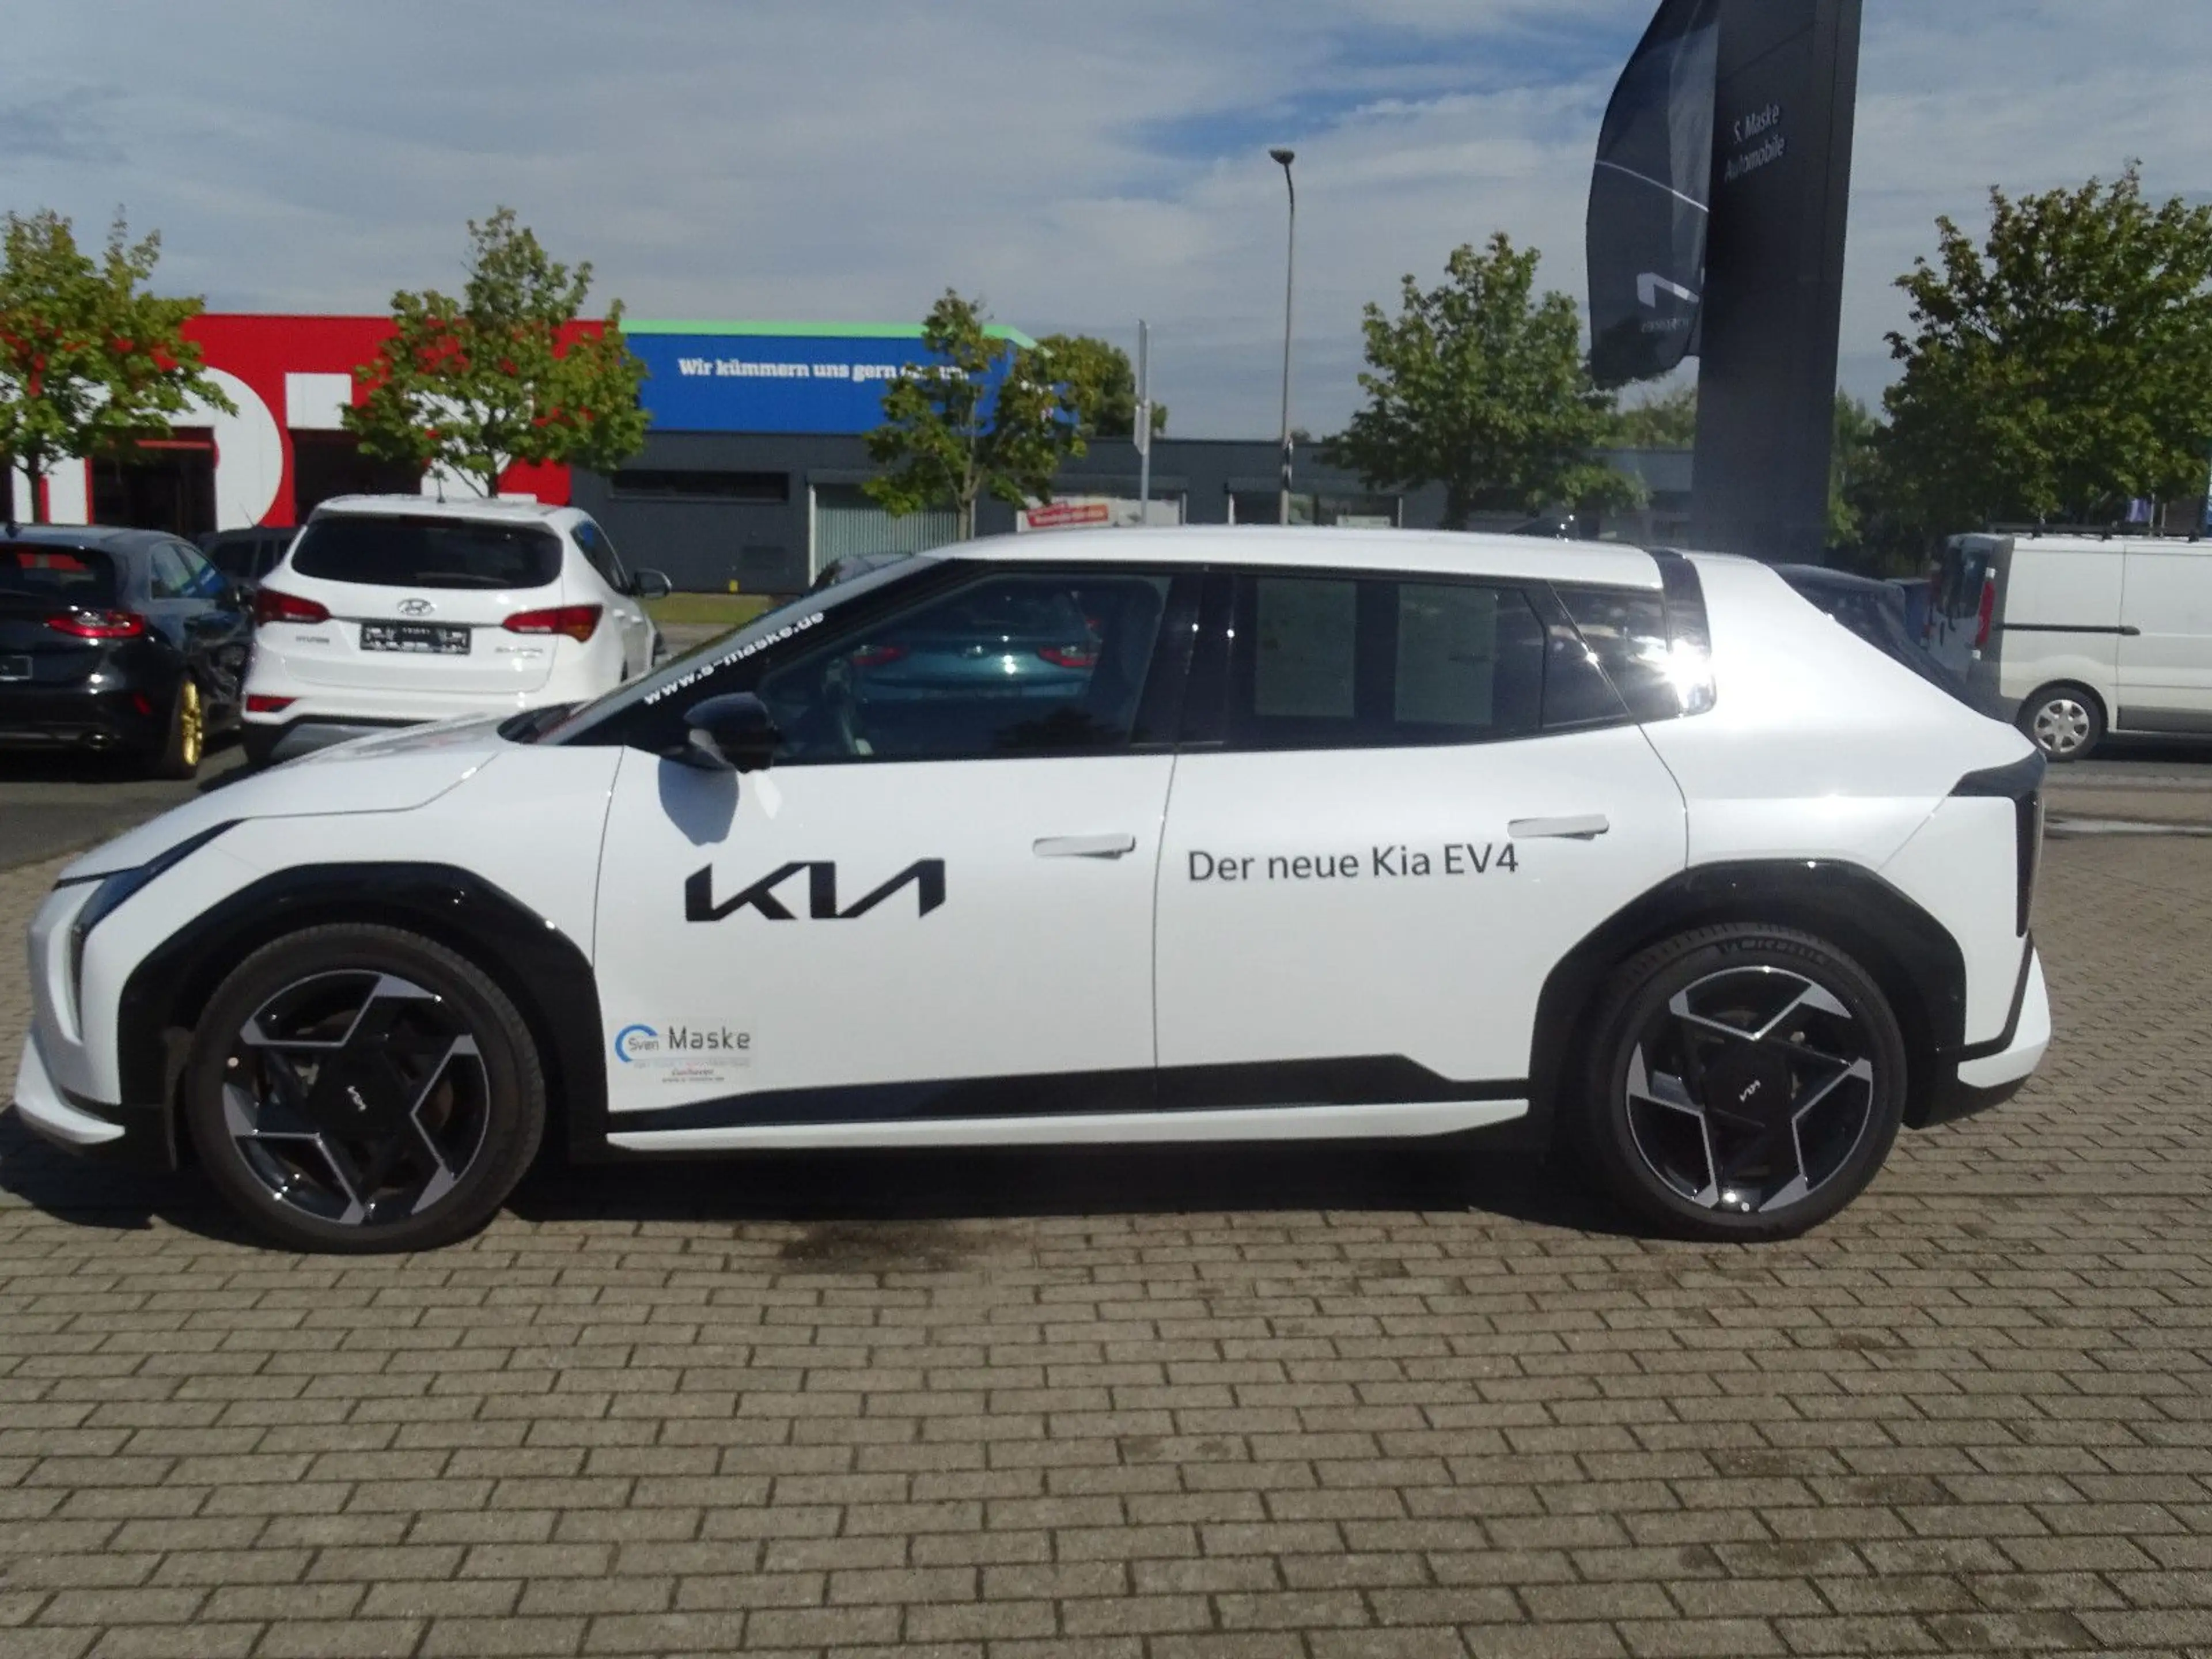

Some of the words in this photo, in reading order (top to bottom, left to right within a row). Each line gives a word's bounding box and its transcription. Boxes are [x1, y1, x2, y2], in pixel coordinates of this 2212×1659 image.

[1744, 103, 1779, 139] Maske
[1724, 134, 1785, 183] Automobile
[677, 358, 713, 376] Wir
[715, 358, 809, 377] kümmern
[812, 363, 850, 378] uns
[853, 364, 897, 382] gern
[644, 612, 824, 705] www.s-maske.de
[1188, 850, 1255, 881] Der
[1267, 854, 1359, 880] neue
[1371, 844, 1431, 878] Kia
[1442, 842, 1518, 875] EV4
[685, 858, 946, 922] KIA
[627, 1036, 659, 1052] Sven
[668, 1024, 751, 1050] Maske
